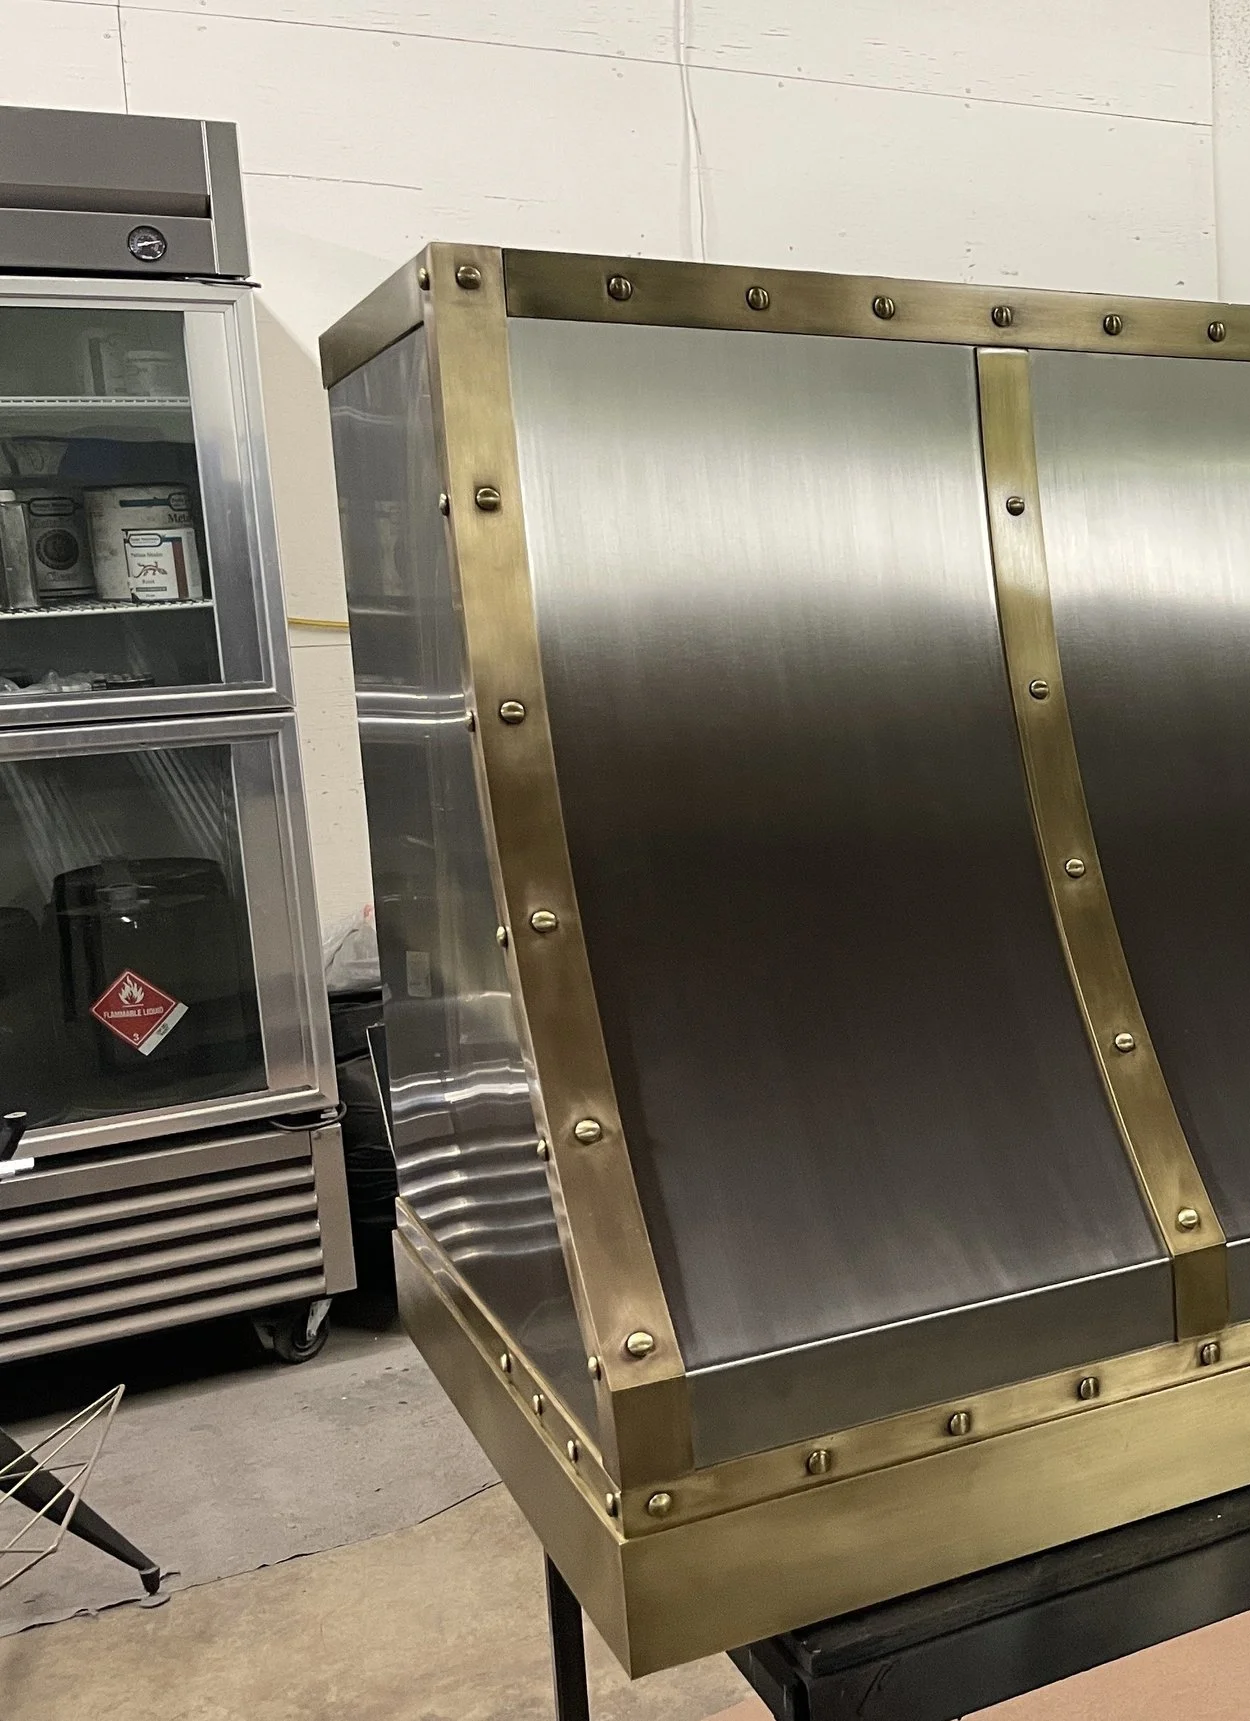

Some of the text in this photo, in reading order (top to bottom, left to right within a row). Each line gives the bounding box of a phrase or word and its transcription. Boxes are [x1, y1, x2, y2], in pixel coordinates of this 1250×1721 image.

[103, 1006, 164, 1019] FLAMMABLE LIQUID
[133, 1033, 140, 1041] 3
